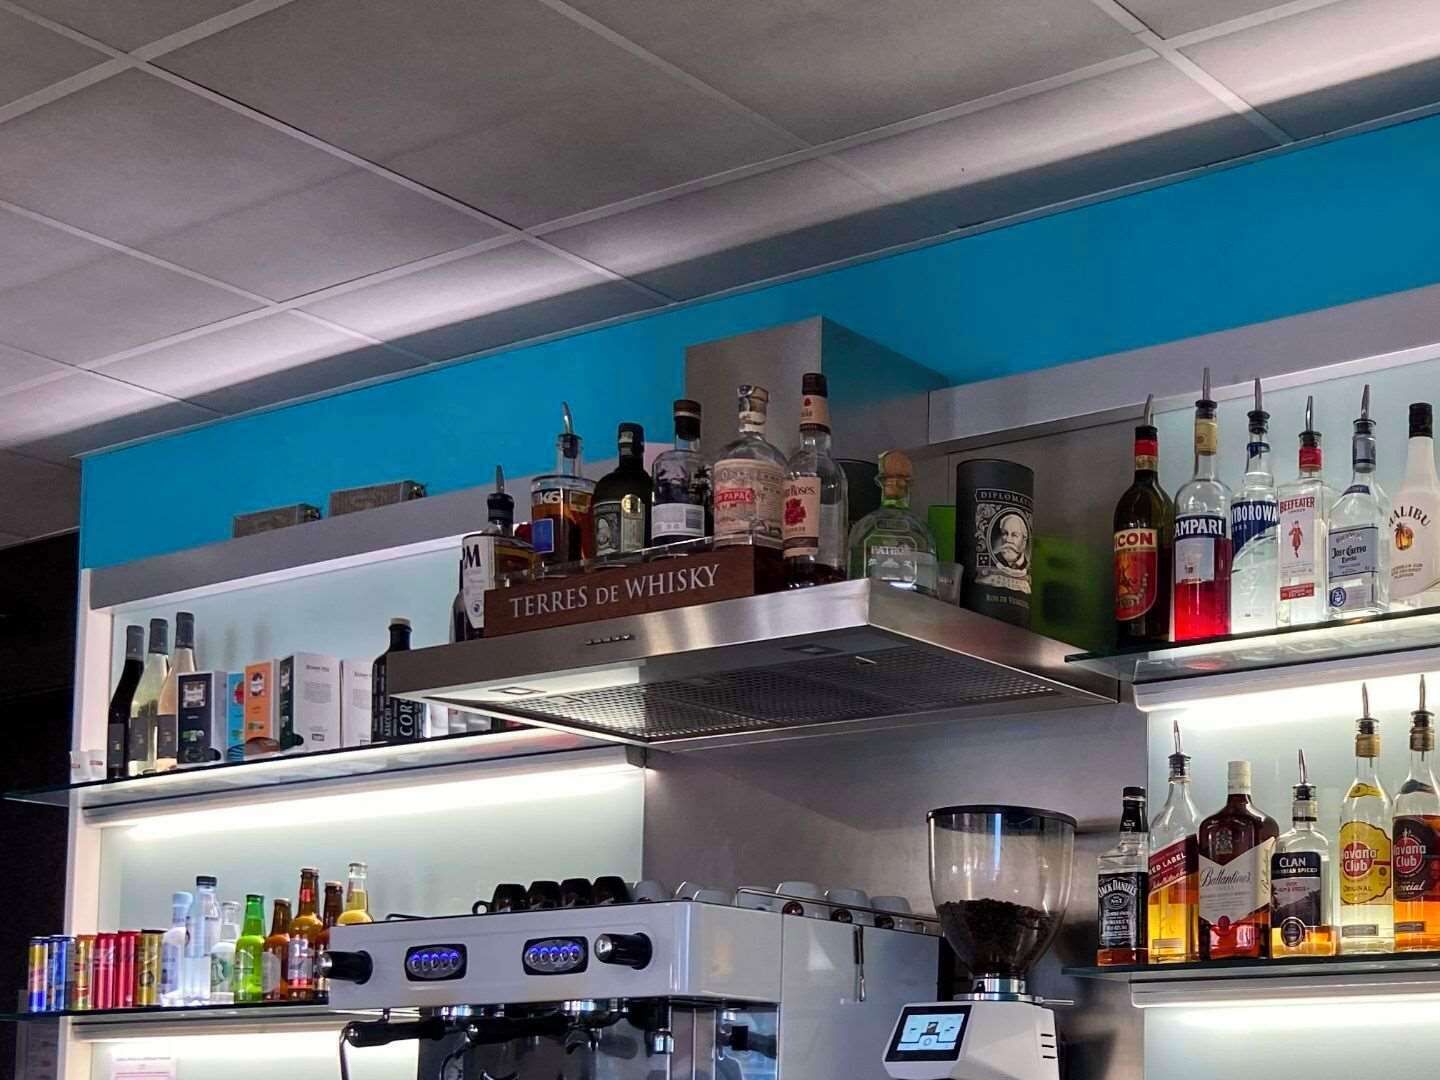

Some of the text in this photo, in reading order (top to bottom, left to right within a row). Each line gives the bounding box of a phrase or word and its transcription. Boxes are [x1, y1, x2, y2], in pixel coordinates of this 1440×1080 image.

[1280, 496, 1315, 514] BEEFEATER
[1175, 518, 1224, 537] AMPARI
[1115, 532, 1153, 547] ICON
[509, 563, 721, 618] TERRES DE WHISKY
[1162, 852, 1187, 868] LABEL
[1344, 848, 1377, 859] avana
[1279, 856, 1306, 868] CLAN
[1345, 860, 1368, 872] Club
[1396, 855, 1417, 868] Club
